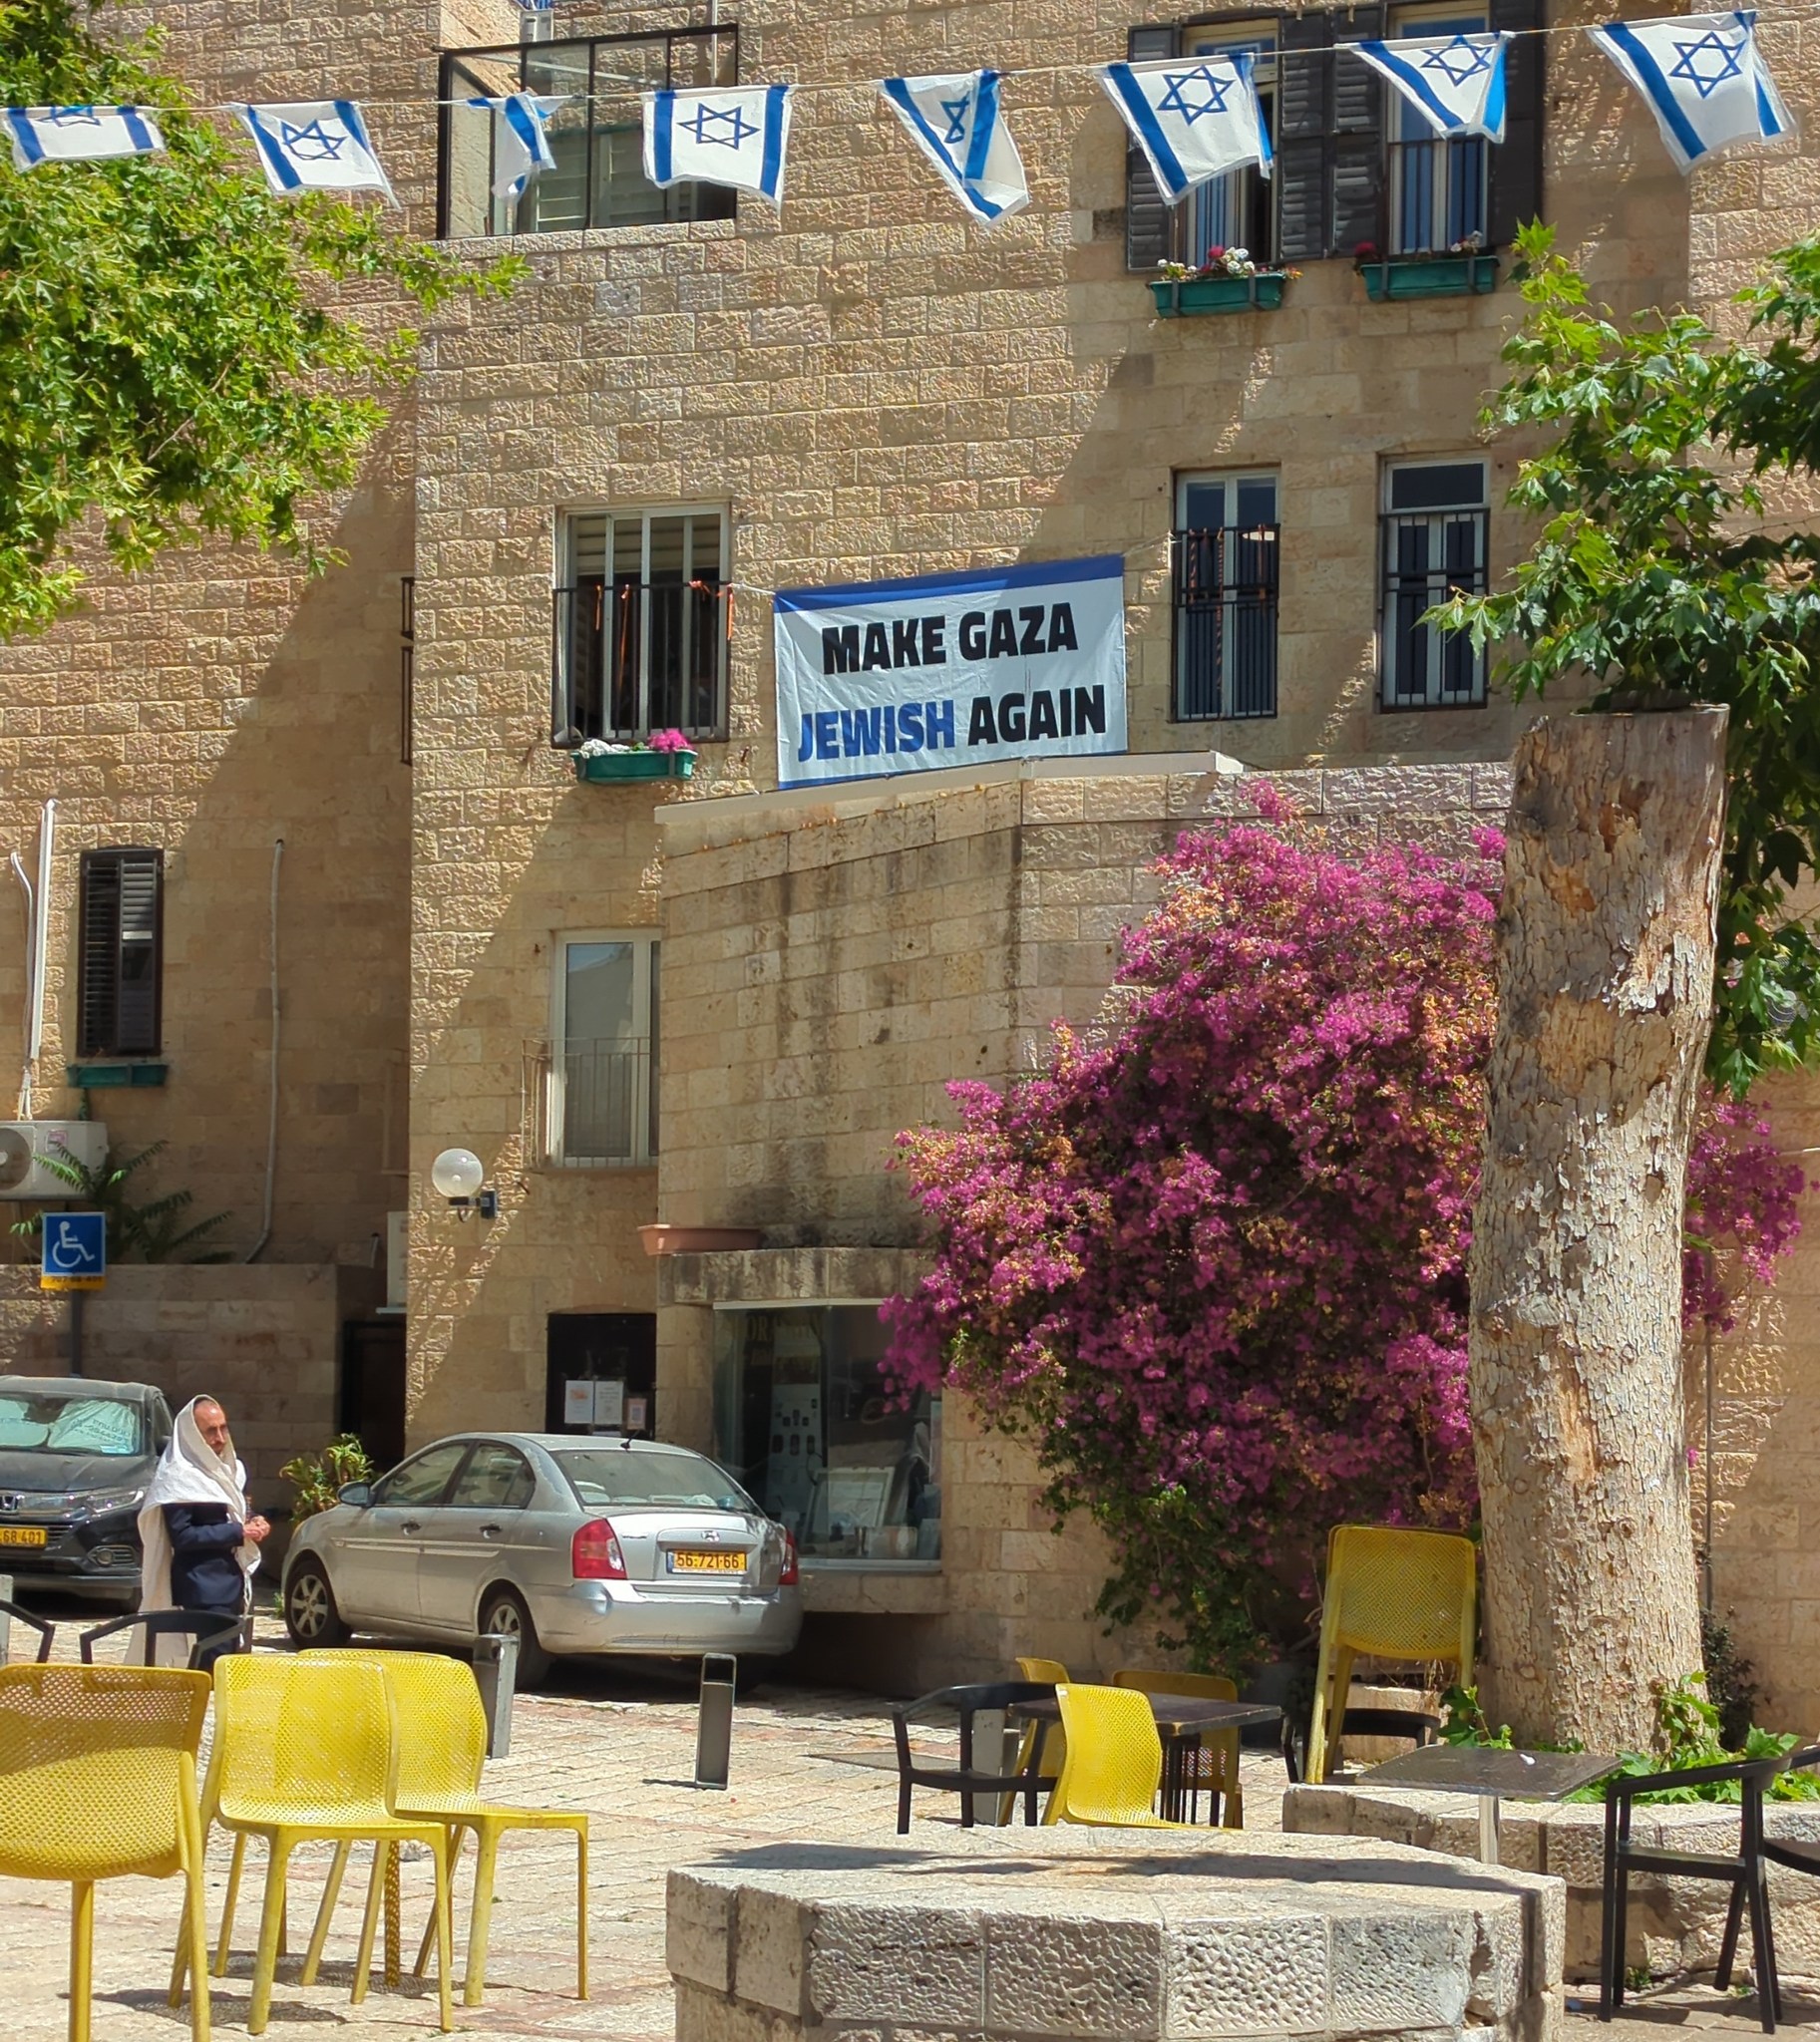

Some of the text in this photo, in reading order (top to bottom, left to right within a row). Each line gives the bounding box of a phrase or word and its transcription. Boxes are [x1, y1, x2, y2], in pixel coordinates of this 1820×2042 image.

[822, 602, 1079, 675] MAKE GAZA
[798, 684, 1106, 762] JEWISH AGAIN
